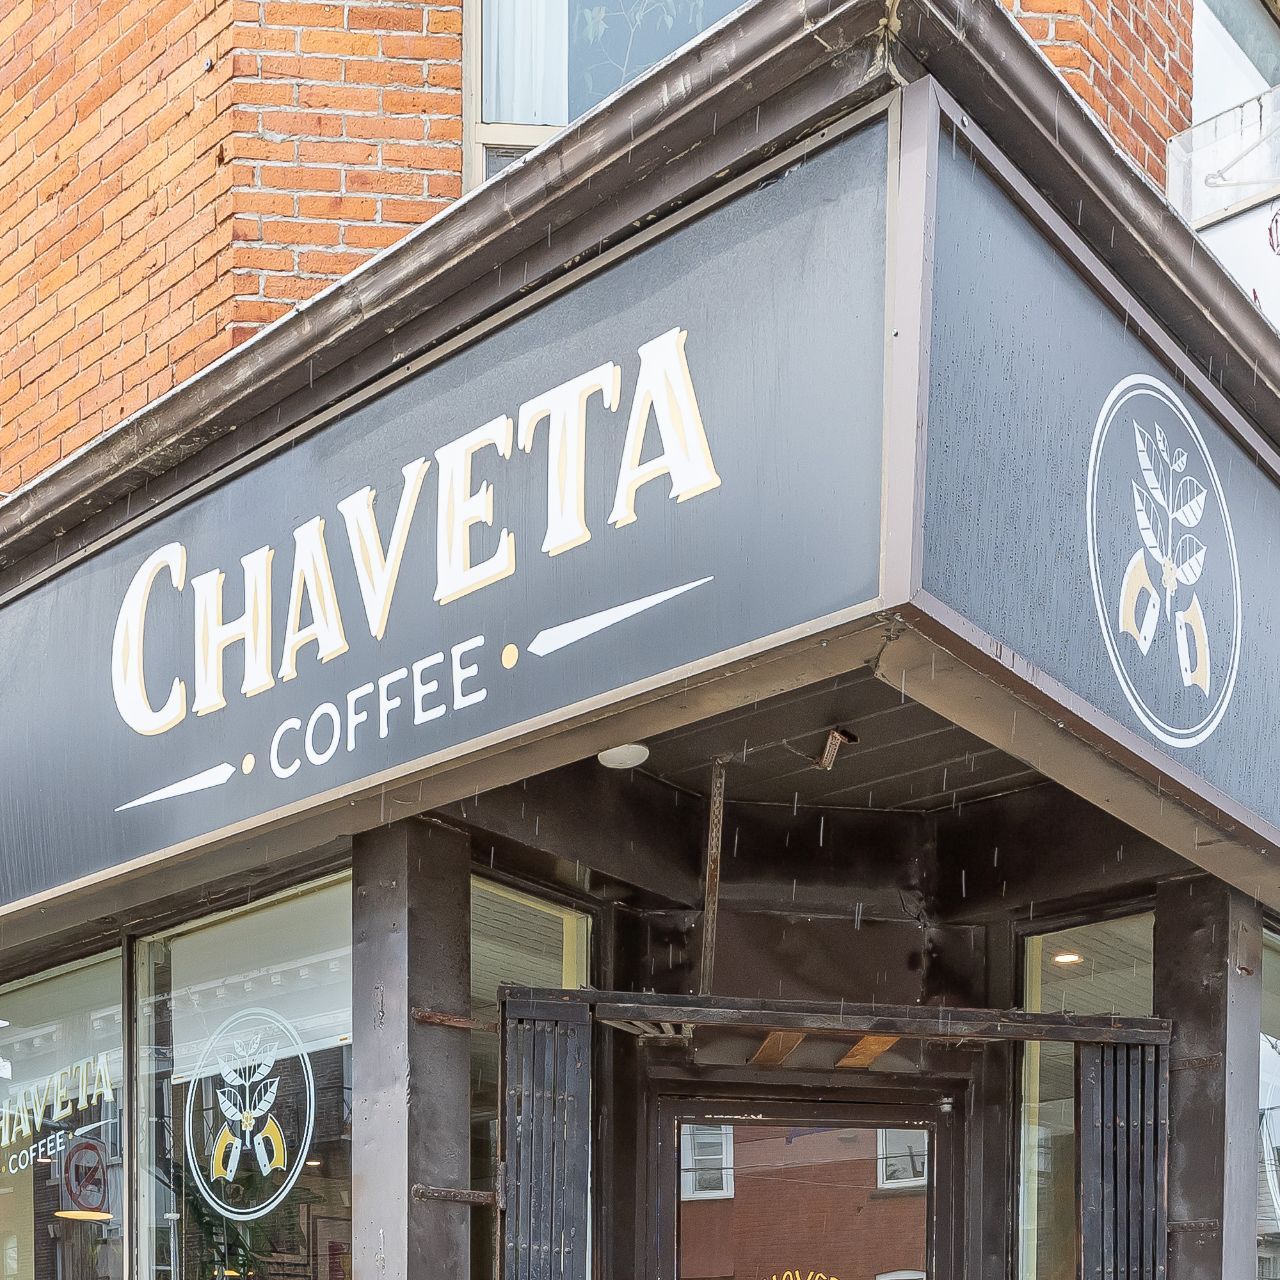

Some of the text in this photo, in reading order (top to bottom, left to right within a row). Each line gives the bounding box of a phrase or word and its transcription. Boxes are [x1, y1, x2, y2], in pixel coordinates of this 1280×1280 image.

[111, 326, 721, 737] CHAVETA
[269, 635, 488, 780] COFFEE
[8, 1130, 66, 1174] COFFEE
